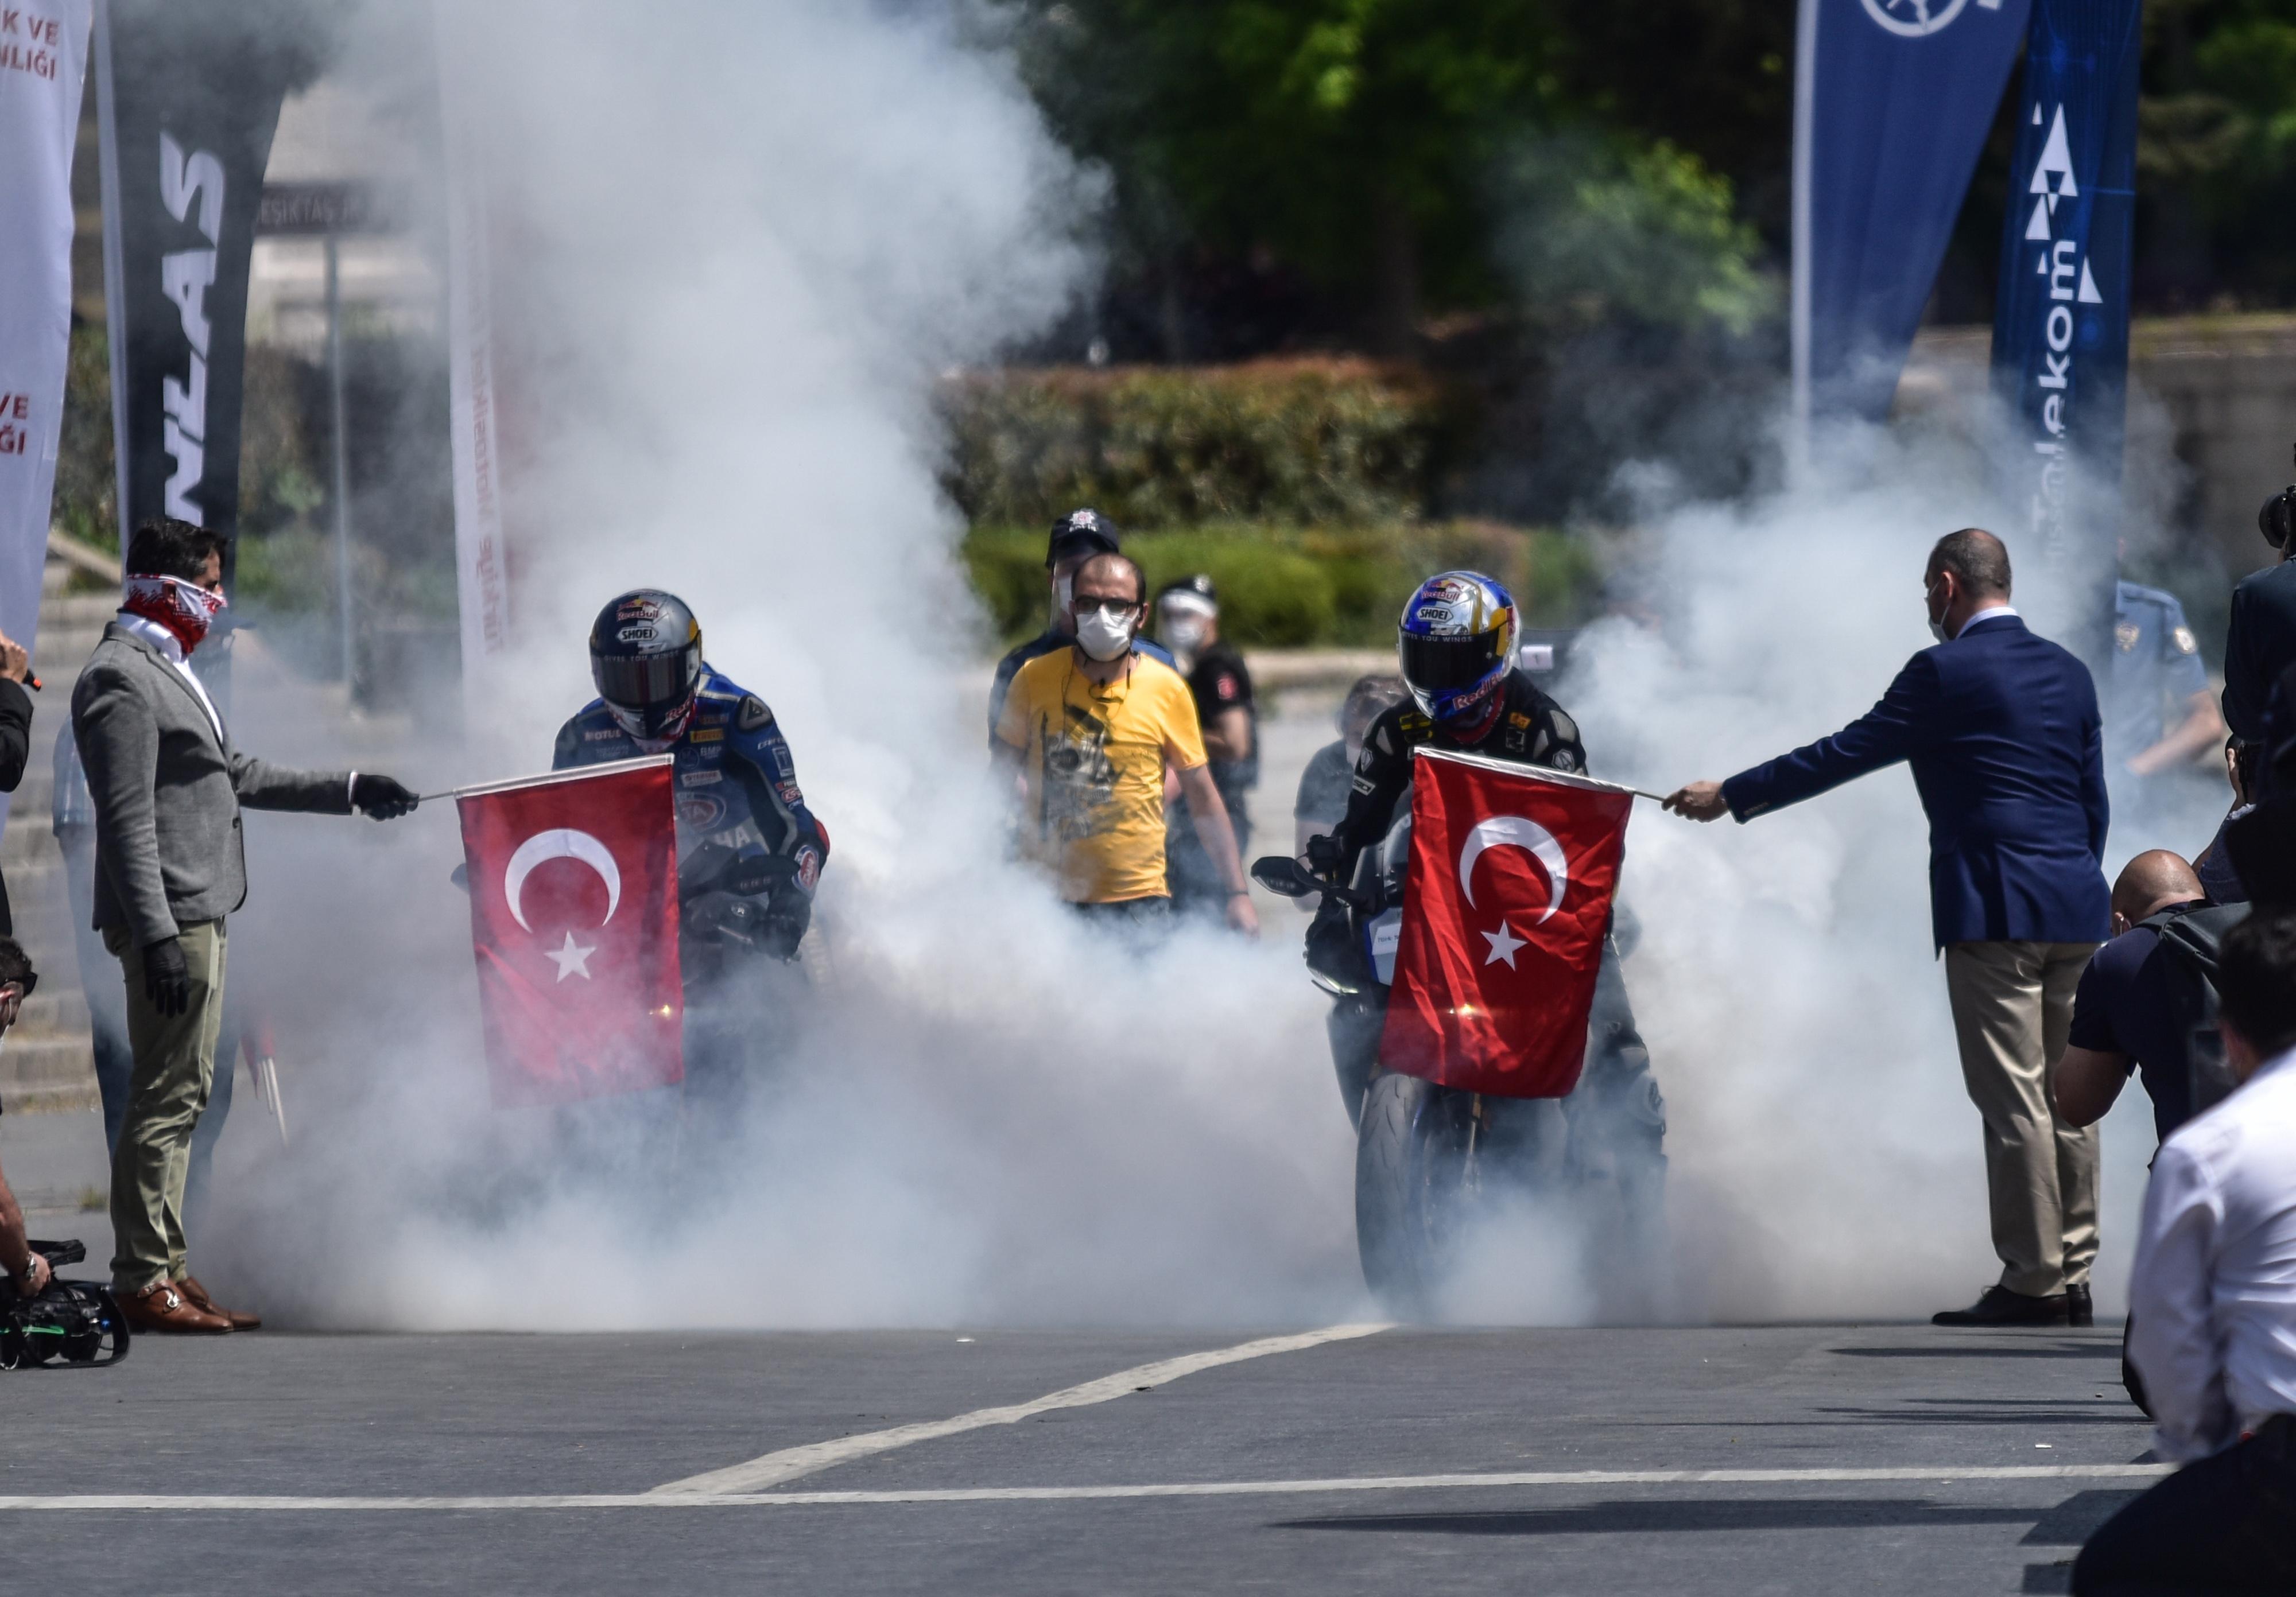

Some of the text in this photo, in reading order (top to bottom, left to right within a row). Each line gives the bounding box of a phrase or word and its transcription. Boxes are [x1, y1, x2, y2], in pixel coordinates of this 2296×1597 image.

[27, 15, 59, 46] VE
[1420, 608, 1448, 620] SHOEI
[622, 629, 653, 640] SHOEI
[584, 729, 622, 741] MOTUL
